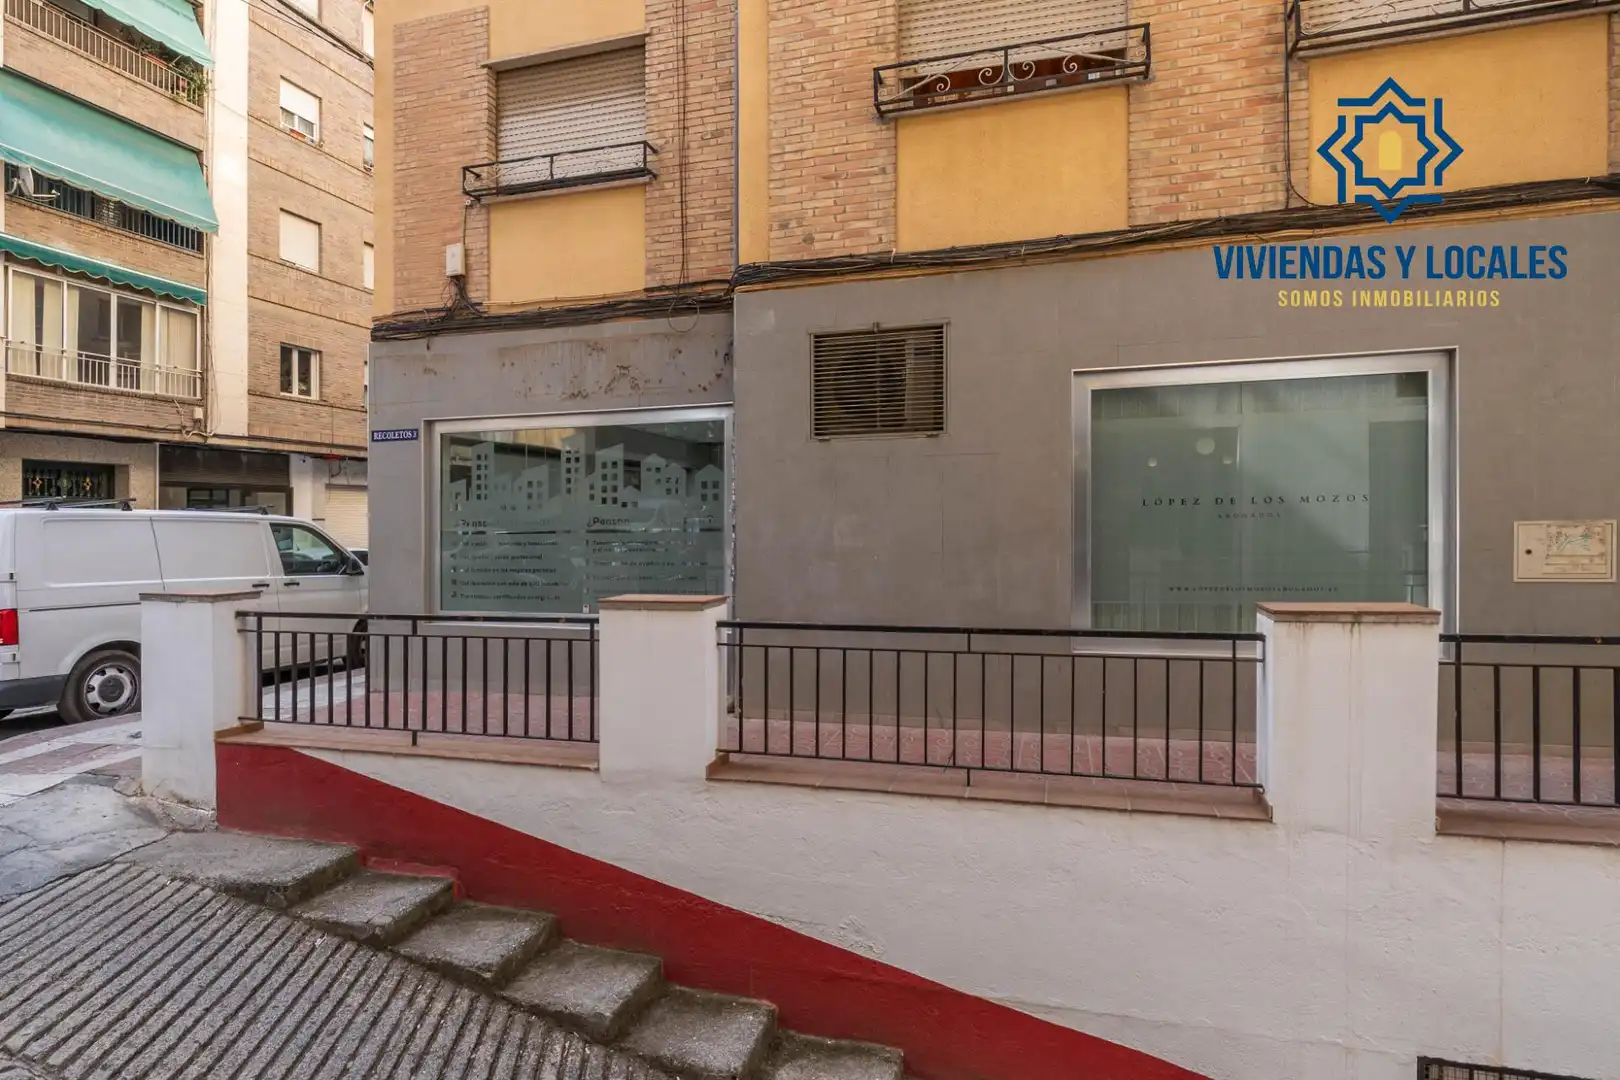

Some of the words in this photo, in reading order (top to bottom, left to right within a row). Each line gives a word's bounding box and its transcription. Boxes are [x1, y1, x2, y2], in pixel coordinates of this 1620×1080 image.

[373, 430, 412, 440] RECOLETOS
[1214, 496, 1237, 506] DE
[1250, 494, 1286, 505] LOS
[1299, 493, 1369, 504] MOZOS
